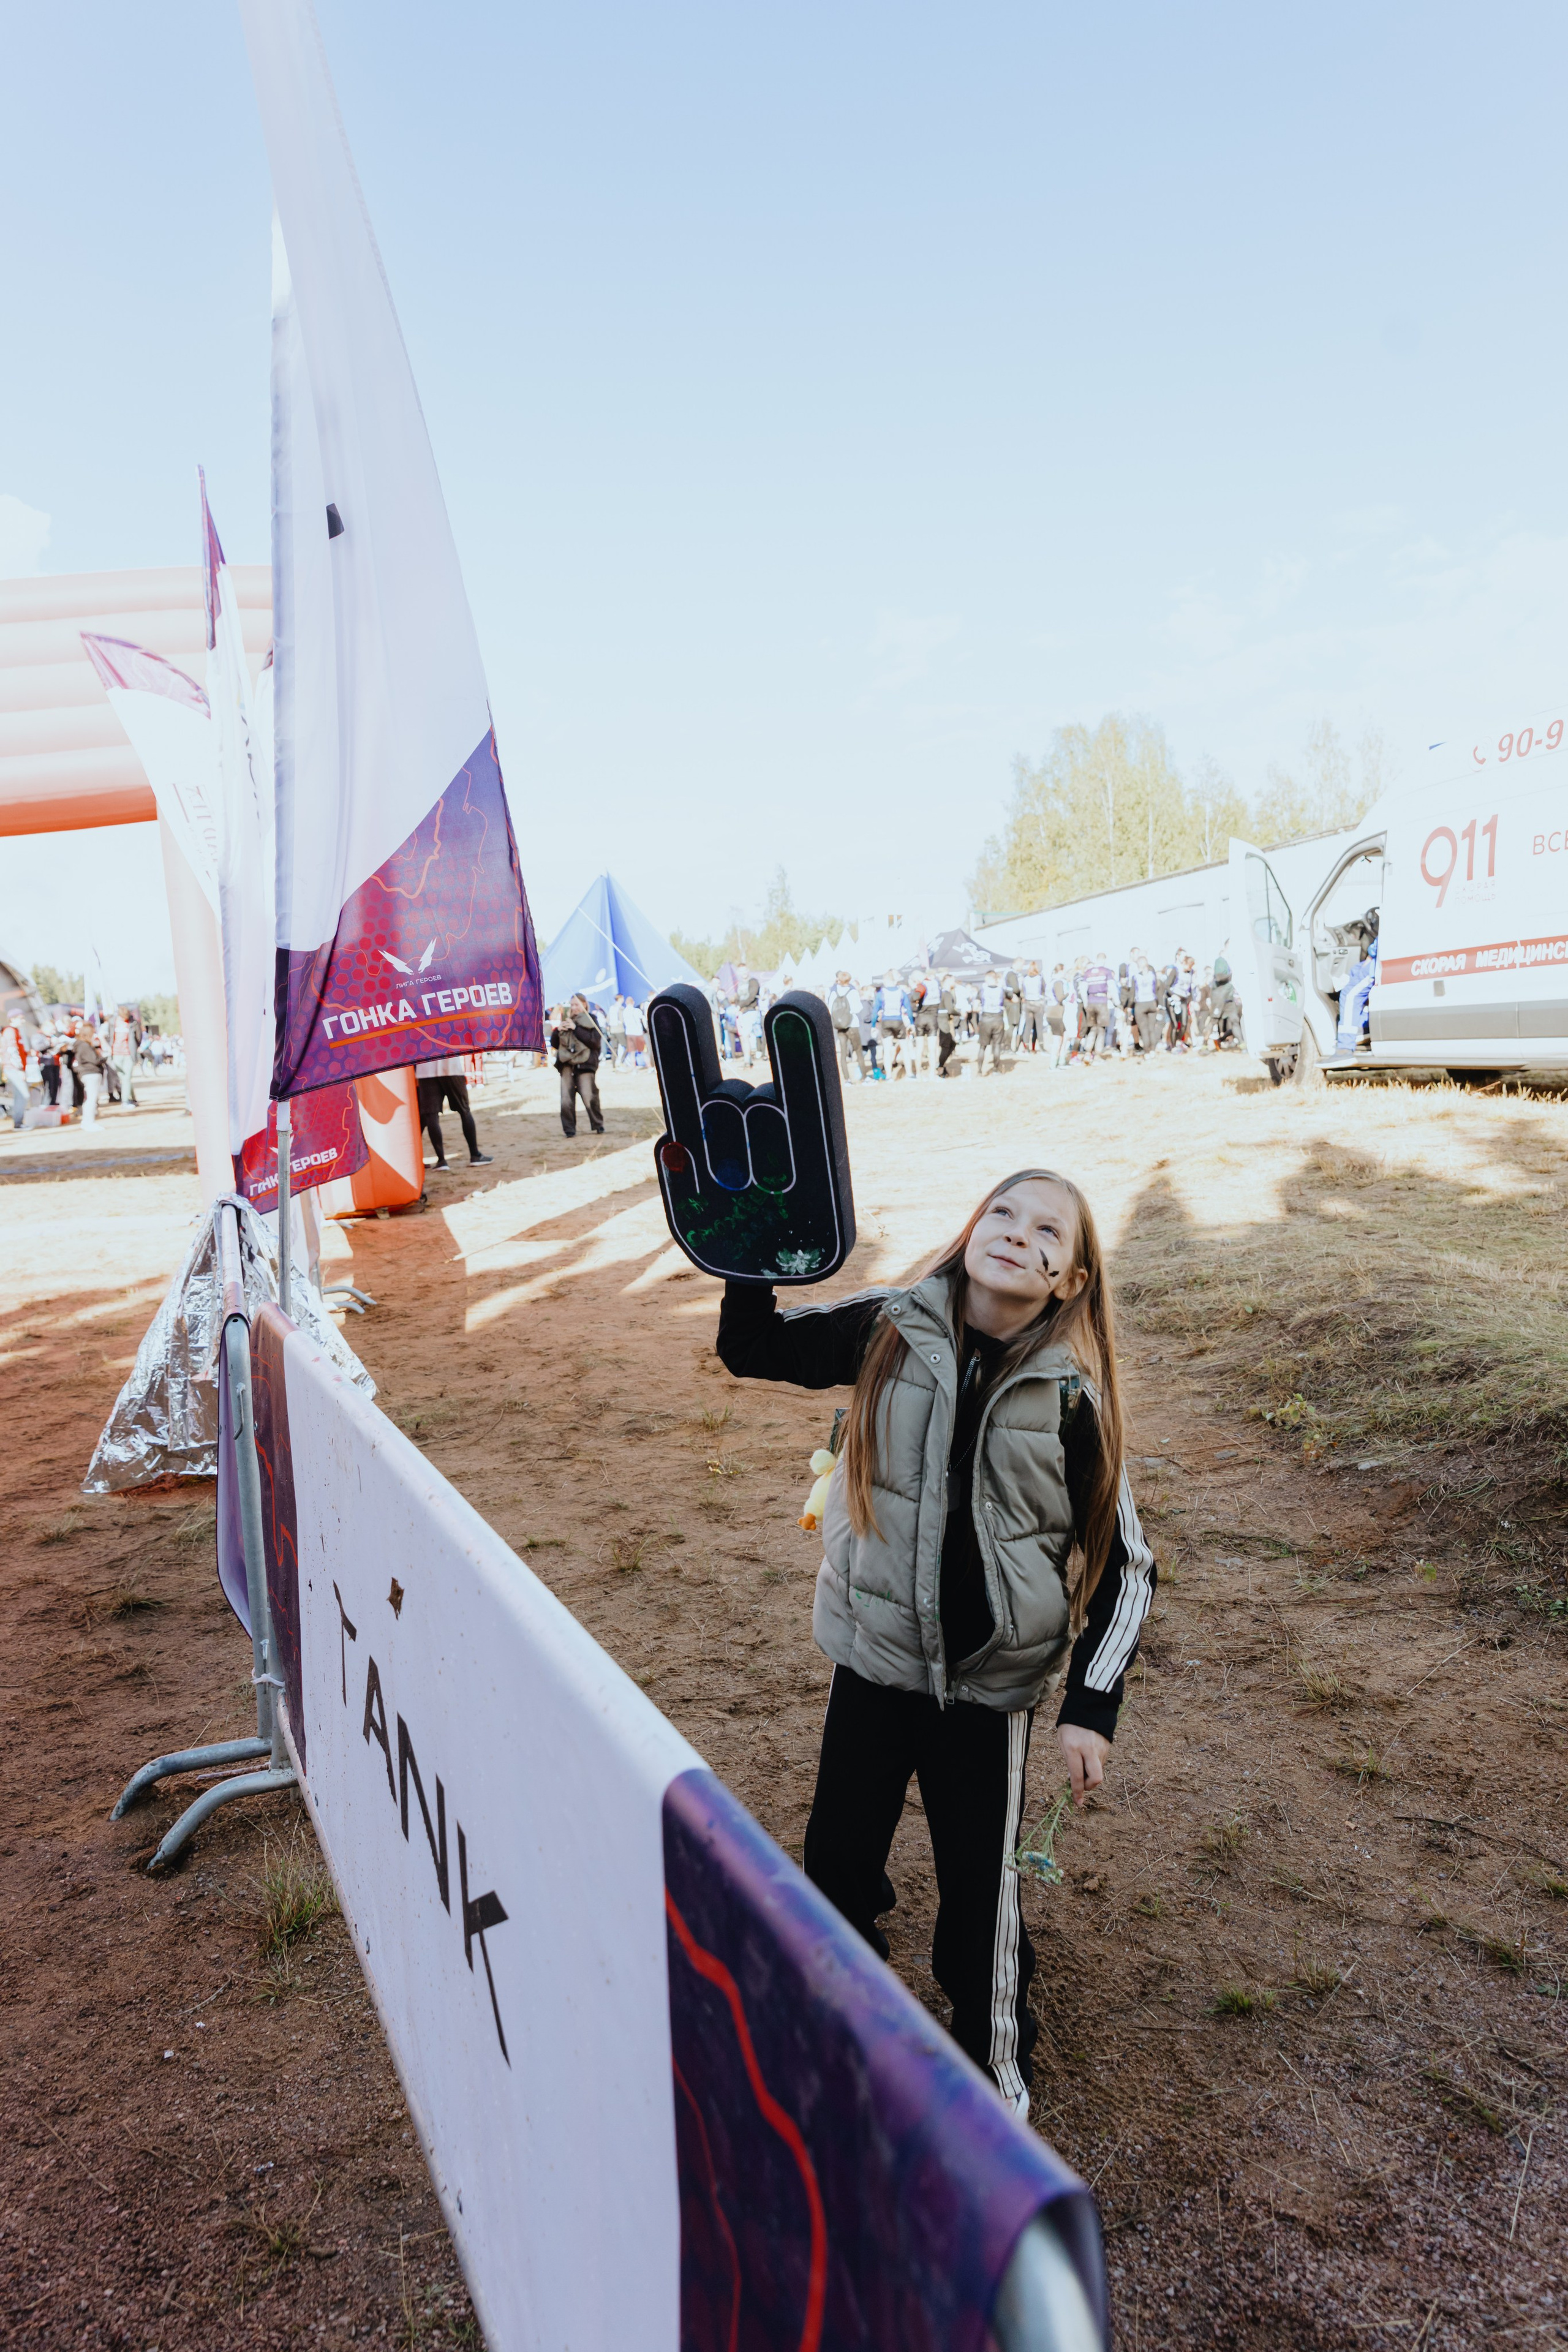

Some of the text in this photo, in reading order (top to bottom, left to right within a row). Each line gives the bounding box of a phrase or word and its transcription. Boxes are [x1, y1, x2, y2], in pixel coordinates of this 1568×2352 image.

[1420, 815, 1499, 909] 911
[1411, 953, 1466, 976] СКОРАЯ
[396, 974, 442, 989] ЛИГА ГЕРОЕВ
[322, 982, 513, 1039] ГОНКА ГЕРОЕВ
[290, 1147, 338, 1173] ЕРОЕВ
